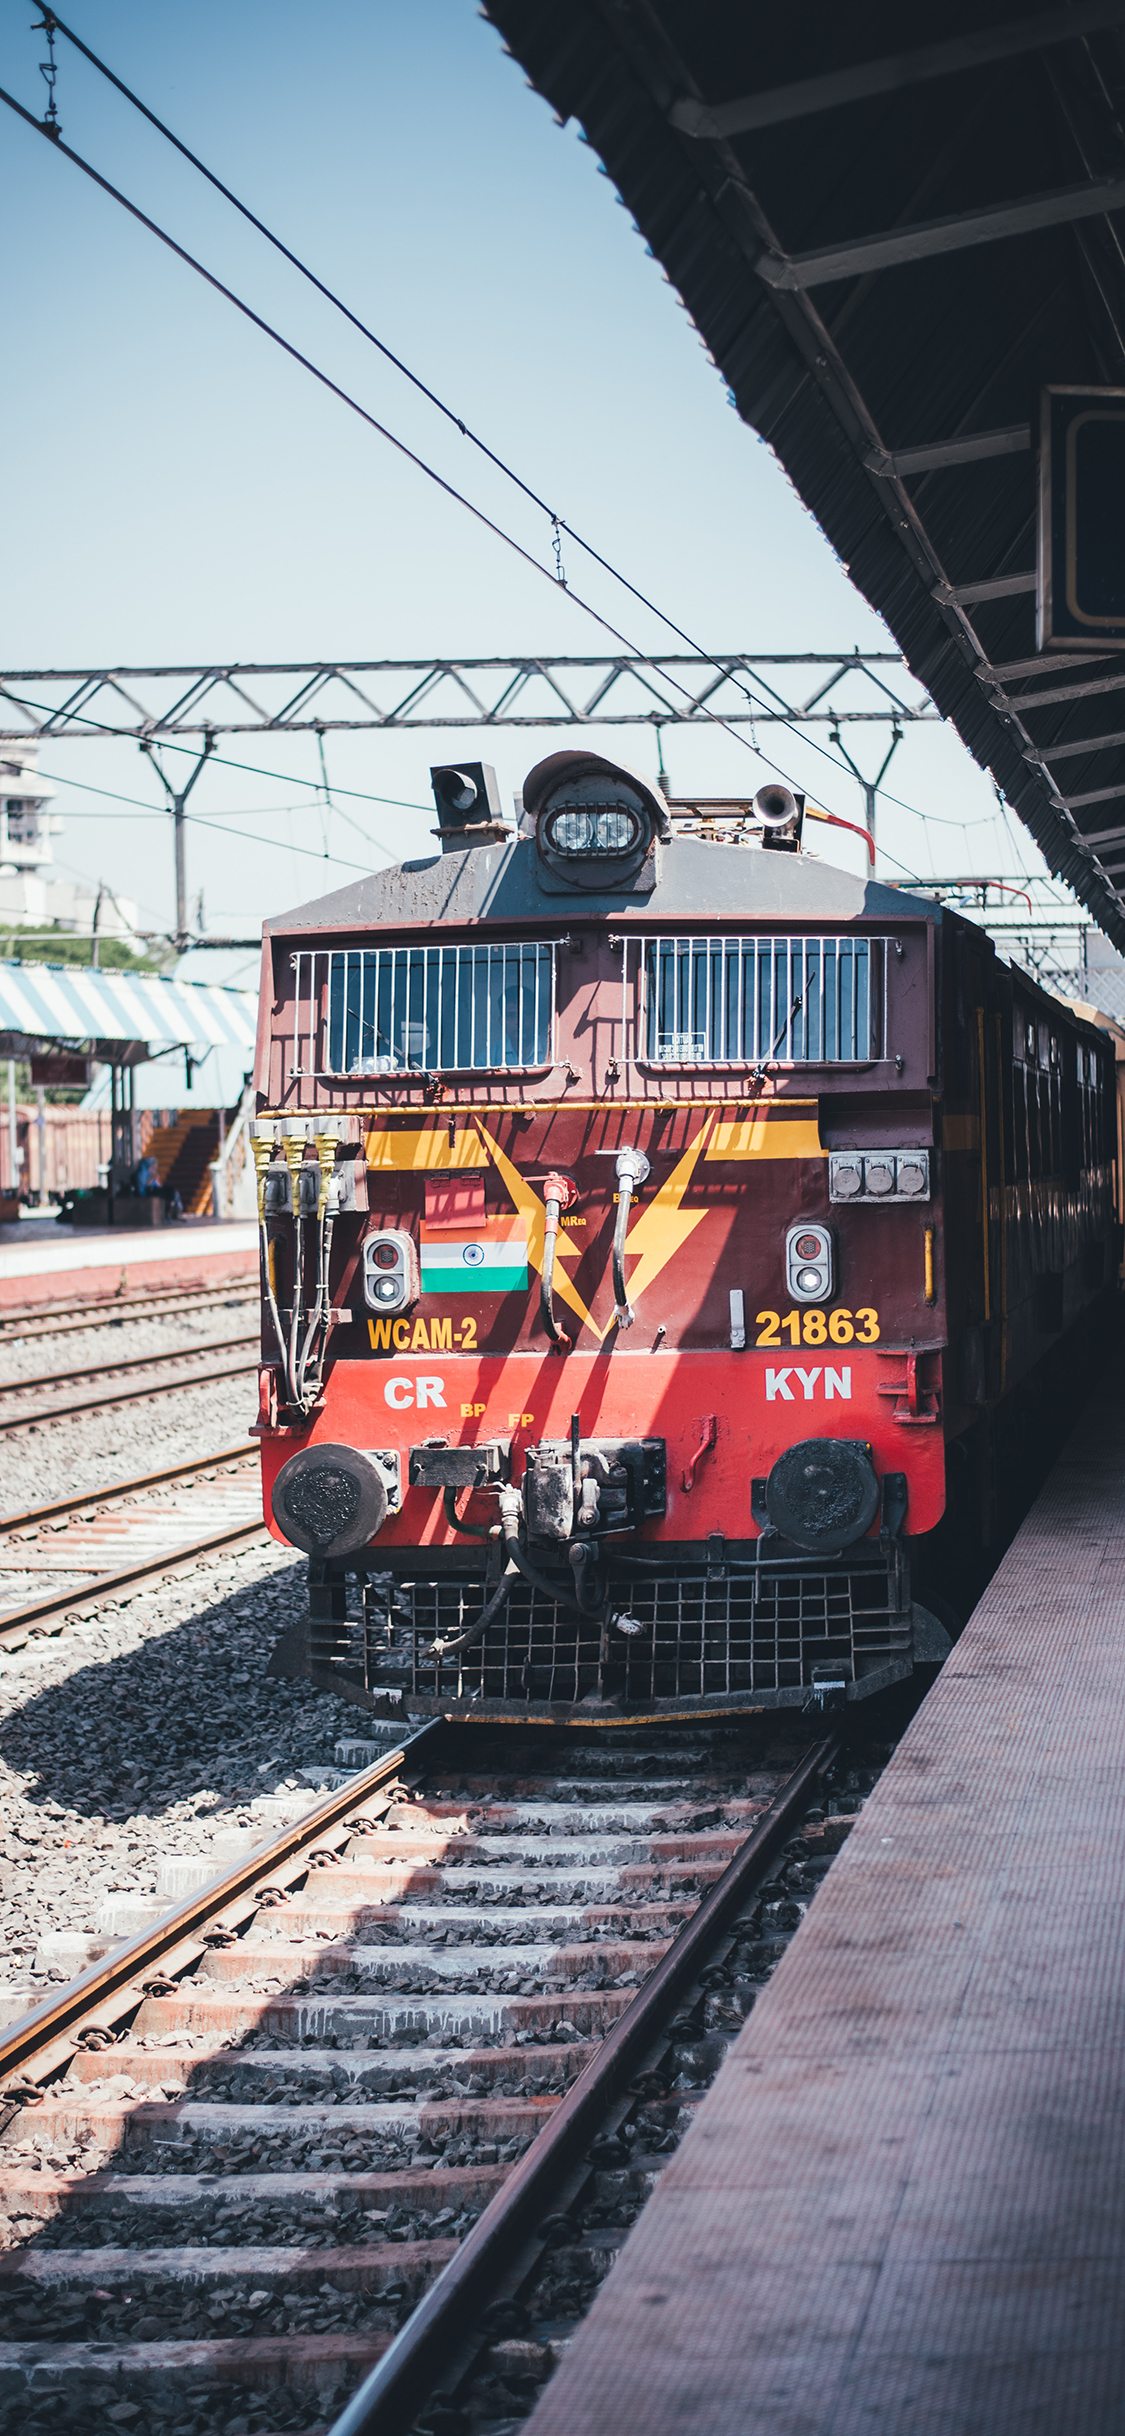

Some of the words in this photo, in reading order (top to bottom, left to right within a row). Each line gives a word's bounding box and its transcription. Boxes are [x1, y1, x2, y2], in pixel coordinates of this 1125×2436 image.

[367, 1317, 477, 1349] WCAM-2
[755, 1307, 880, 1346] 21863
[384, 1376, 447, 1409] CR
[765, 1366, 851, 1401] KYN
[460, 1403, 486, 1417] BP
[508, 1413, 535, 1427] FP
